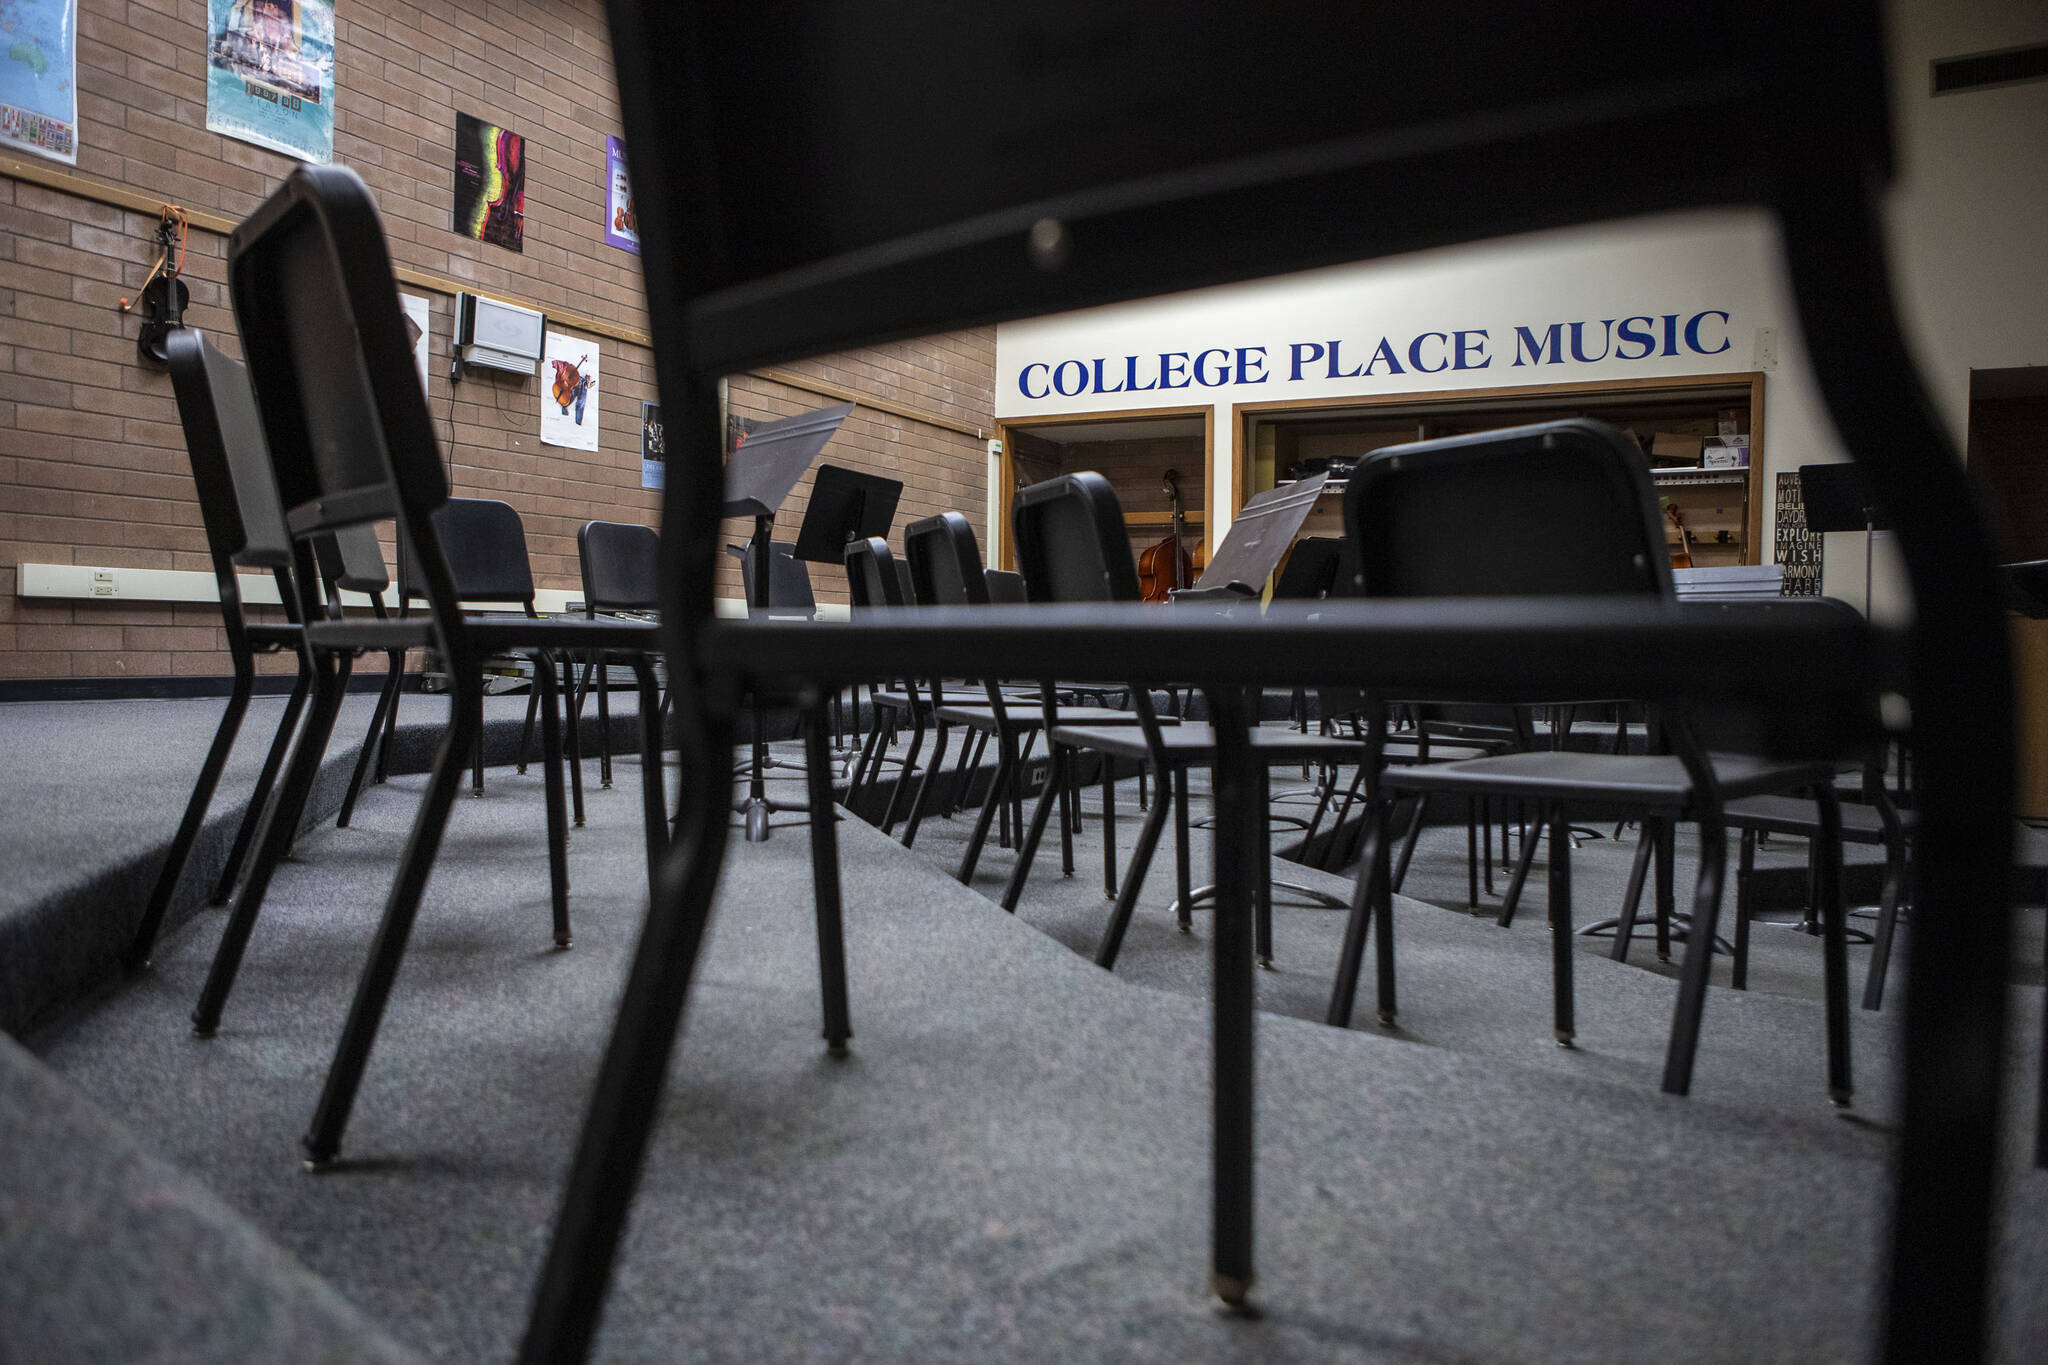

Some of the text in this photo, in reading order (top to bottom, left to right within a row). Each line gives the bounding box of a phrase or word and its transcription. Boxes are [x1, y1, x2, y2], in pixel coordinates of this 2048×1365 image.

[1018, 310, 1732, 399] COLLEGE PLACE MUSIC
[1776, 542, 1822, 550] IMAGINE
[1776, 550, 1821, 562] WISH
[1783, 565, 1821, 578] ARMONY
